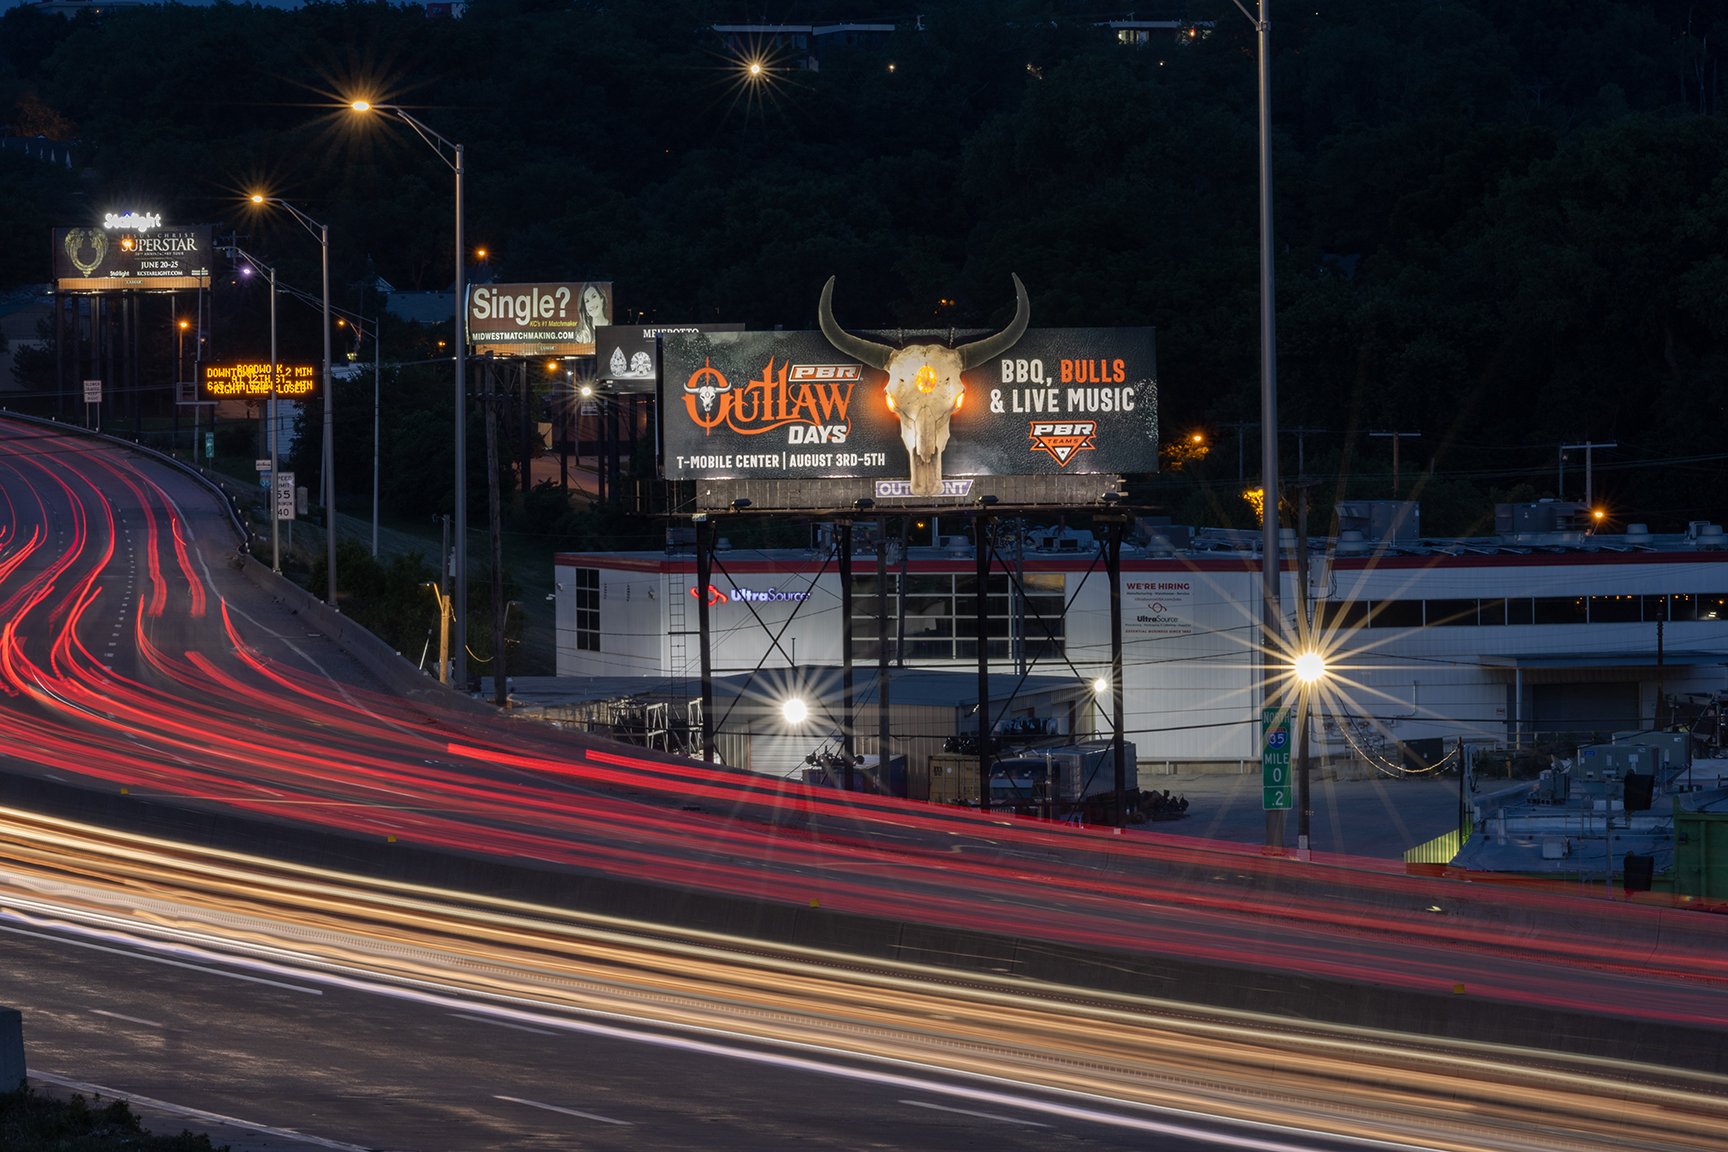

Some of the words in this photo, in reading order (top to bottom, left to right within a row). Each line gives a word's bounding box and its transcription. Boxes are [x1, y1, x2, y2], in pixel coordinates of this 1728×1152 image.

[121, 238, 198, 252] SUPERSTAR
[141, 261, 158, 269] JUNE
[472, 286, 571, 326] Single?
[472, 331, 574, 341] MIDWESTMATCHMAKING.COM
[295, 367, 313, 376] MIN
[794, 366, 857, 378] PBR
[1001, 359, 1053, 387] BBQ,
[1060, 359, 1126, 383] BULLS
[990, 389, 1005, 413] &
[1012, 388, 1060, 412] LIVE
[1067, 387, 1135, 412] MUSIC
[788, 425, 847, 444] DAYS
[1033, 424, 1094, 436] PBR
[676, 455, 733, 469] T-MOBILE
[735, 454, 780, 468] CENTER
[789, 453, 833, 467] AUGUST
[836, 452, 886, 466] 3RD-5TH
[879, 482, 967, 495] OUTNT
[731, 587, 809, 601] UltraSource
[1263, 711, 1290, 724] NORTH
[1269, 733, 1285, 744] 35
[1264, 752, 1289, 765] MILE
[1273, 768, 1282, 782] 0
